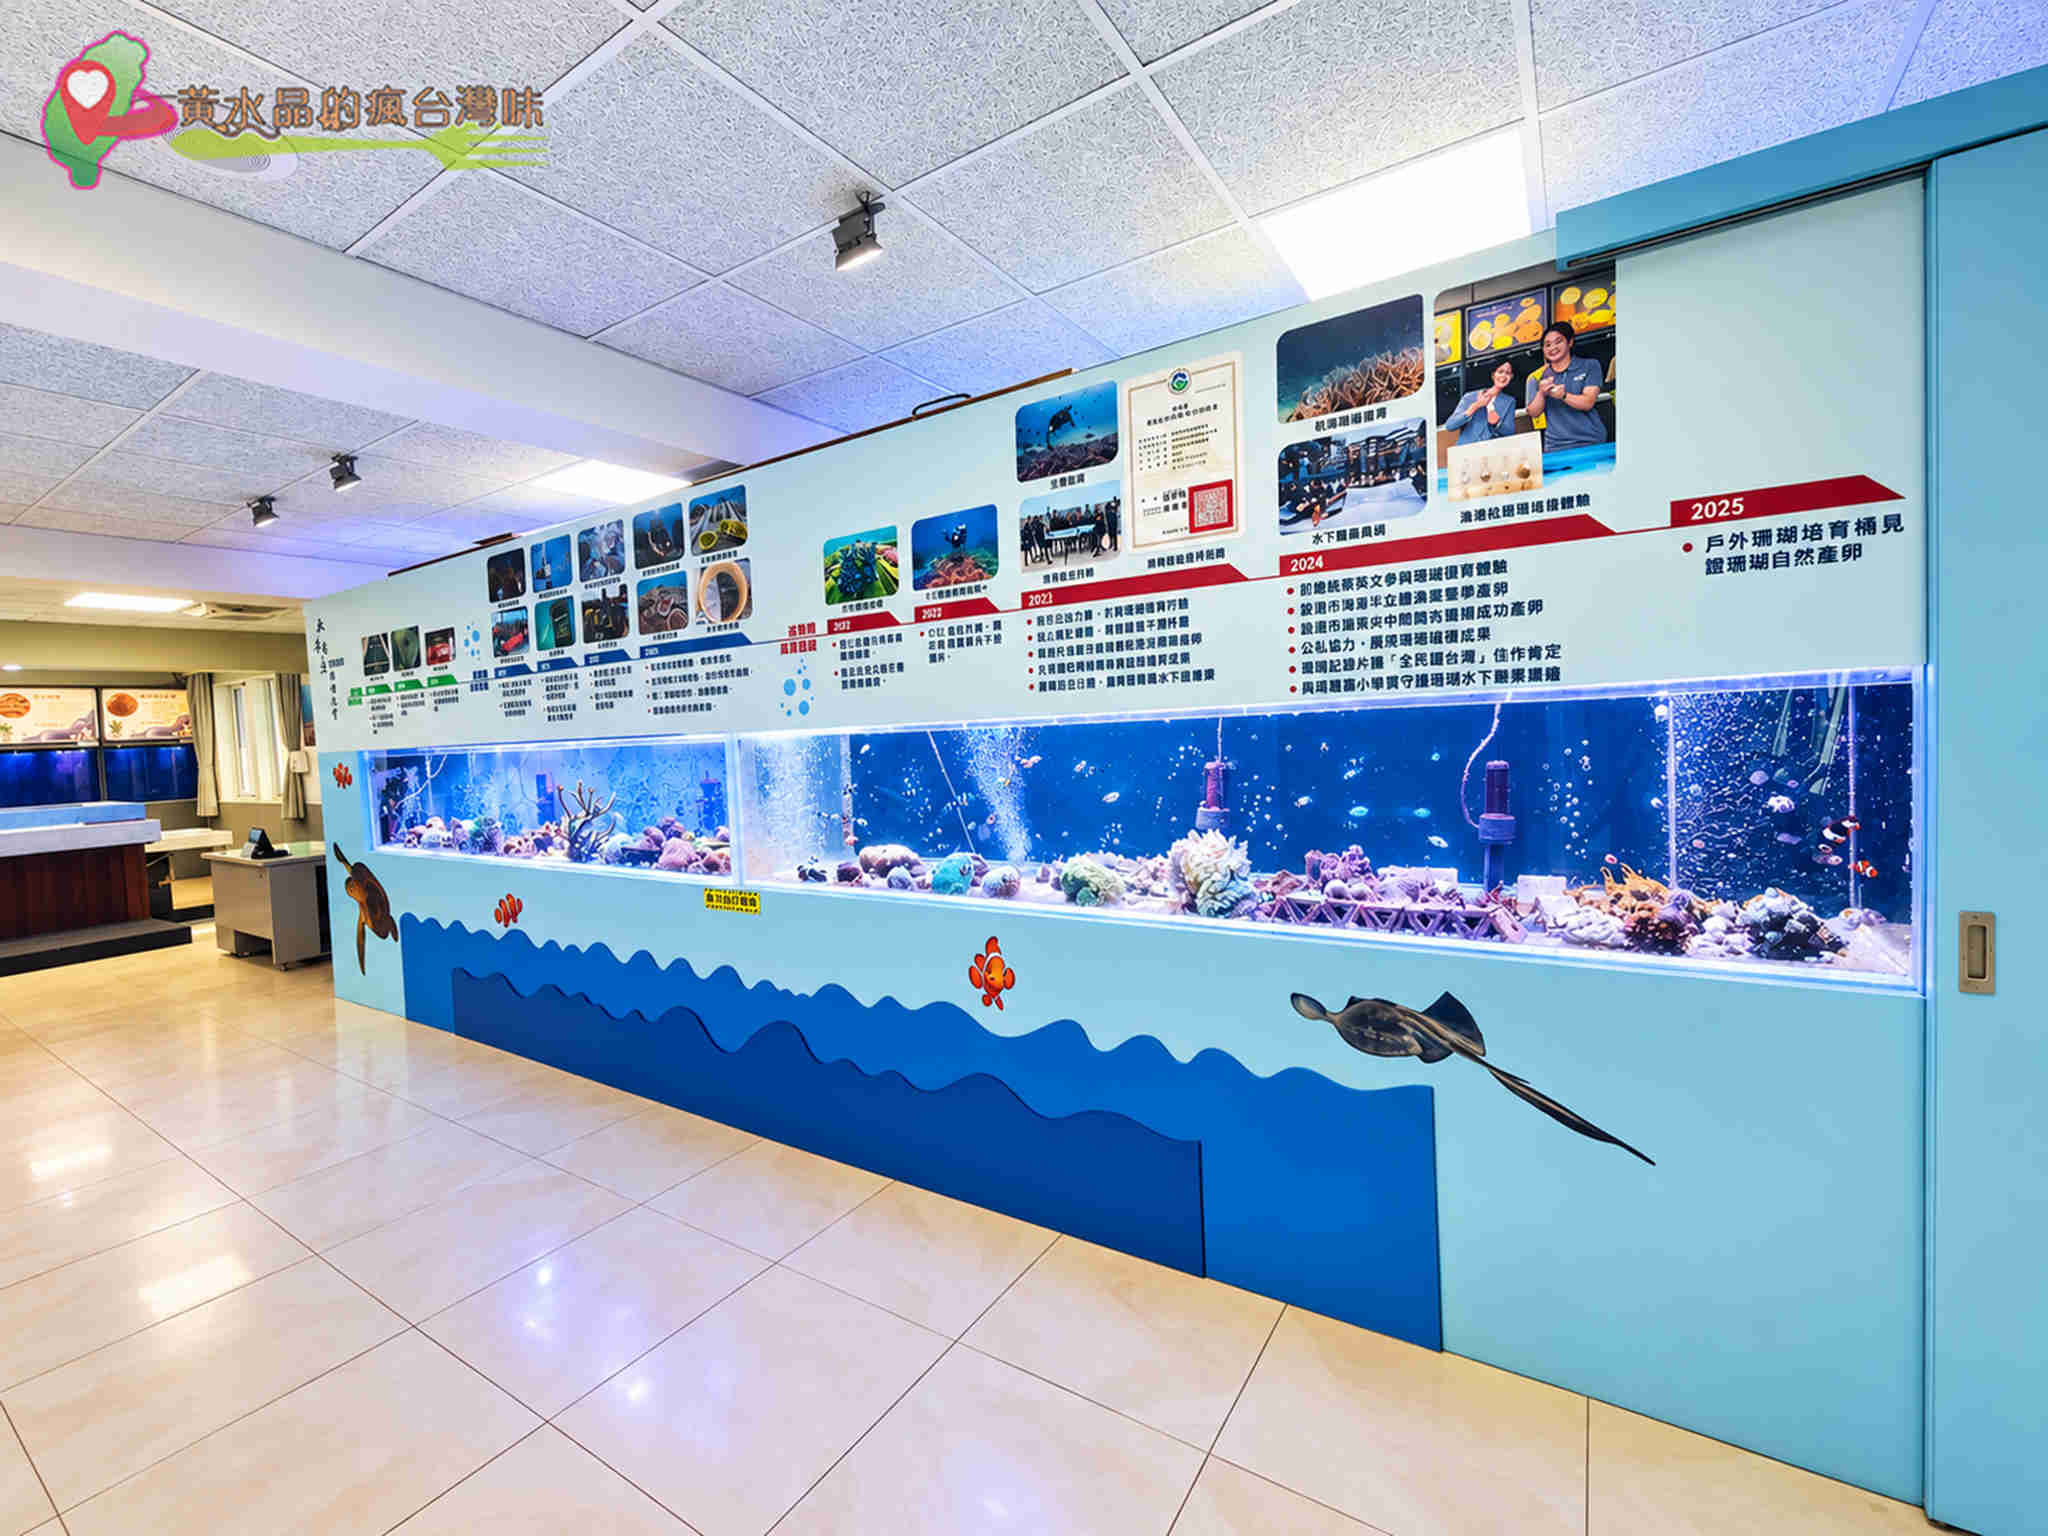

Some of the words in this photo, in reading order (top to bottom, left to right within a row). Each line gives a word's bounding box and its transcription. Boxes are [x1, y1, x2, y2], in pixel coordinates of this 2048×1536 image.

[1691, 497, 1745, 521] 2025
[1705, 513, 1905, 553] 戶外珊瑚培育桶見
[1290, 554, 1325, 573] 2024
[1705, 543, 1863, 576] 證珊瑚自然產卵
